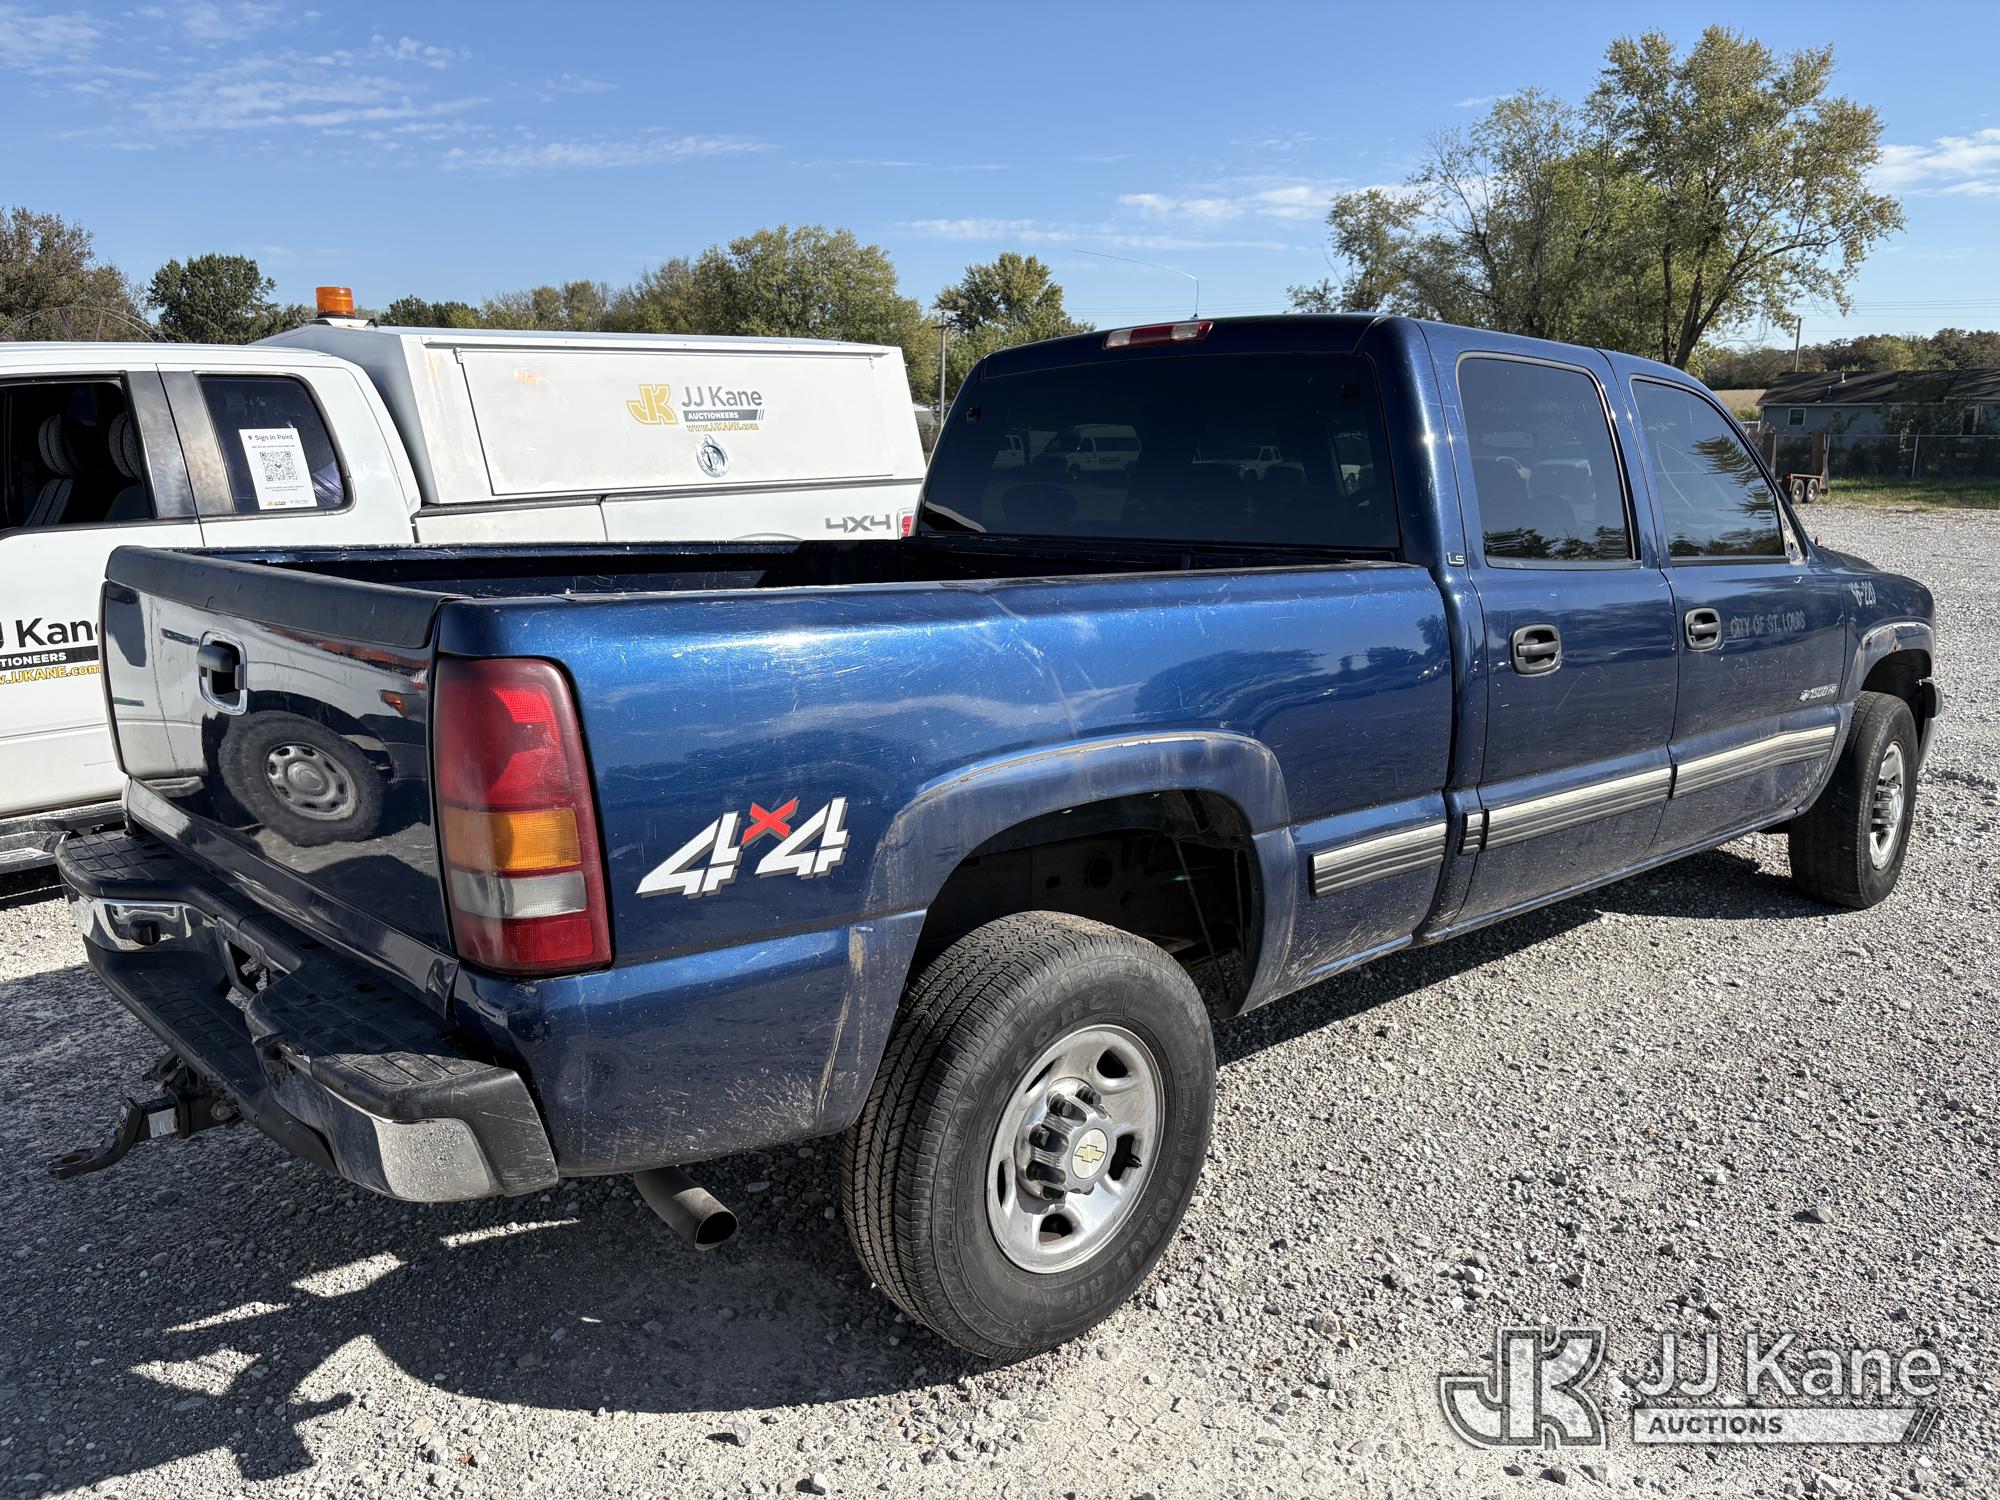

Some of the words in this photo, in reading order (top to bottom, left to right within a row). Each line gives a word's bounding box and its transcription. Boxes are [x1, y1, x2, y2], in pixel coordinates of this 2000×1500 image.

[682, 386, 704, 407] JJ
[708, 386, 762, 407] Kane
[688, 411, 739, 420] AUCTIONEERS
[1447, 553, 1464, 565] LS
[16, 617, 98, 648] Kan
[1730, 616, 1750, 638] CITY
[1753, 615, 1765, 635] OF
[1767, 613, 1780, 633] ST.
[1782, 610, 1806, 632] LOUIS
